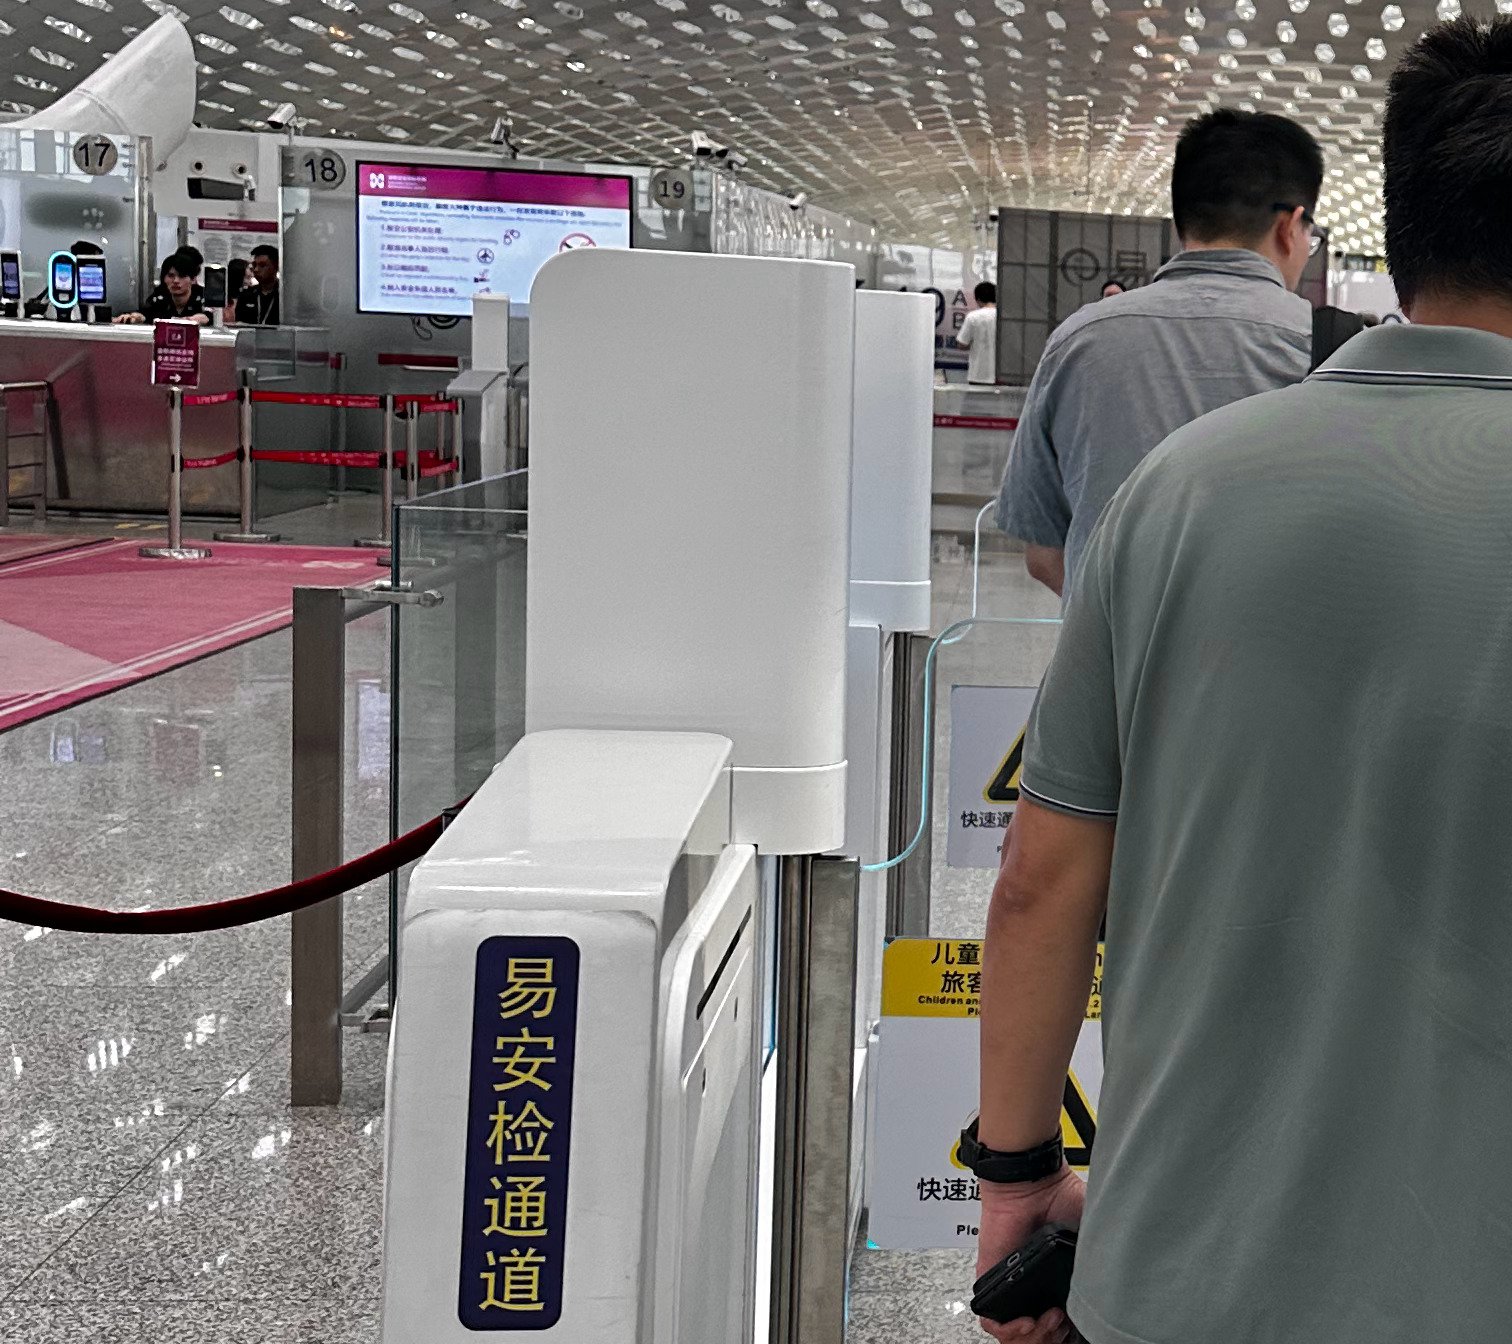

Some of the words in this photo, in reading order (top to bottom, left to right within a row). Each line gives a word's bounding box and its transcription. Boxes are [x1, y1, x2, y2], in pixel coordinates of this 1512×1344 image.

[78, 142, 112, 168] 17
[304, 157, 338, 183] 18
[659, 180, 686, 199] 19
[952, 288, 969, 307] A
[952, 311, 967, 330] B
[918, 995, 964, 1005] Children
[965, 997, 981, 1006] an
[477, 957, 559, 1312] 易安检通道
